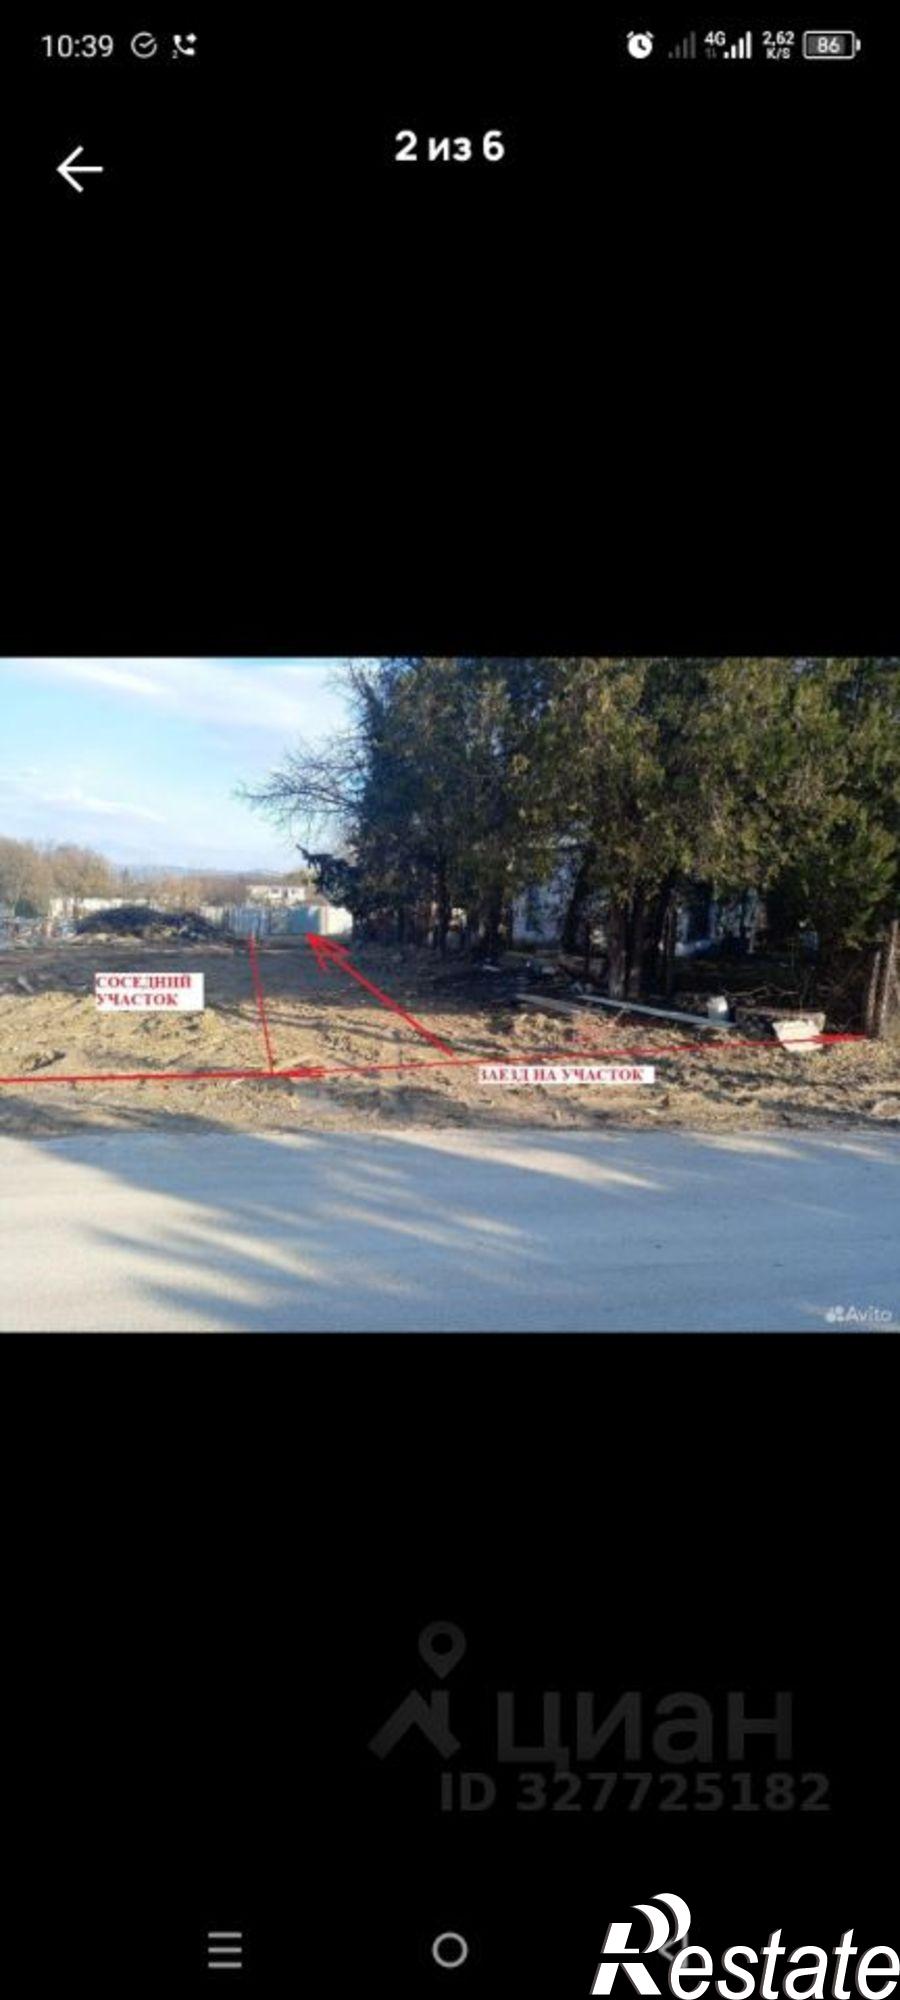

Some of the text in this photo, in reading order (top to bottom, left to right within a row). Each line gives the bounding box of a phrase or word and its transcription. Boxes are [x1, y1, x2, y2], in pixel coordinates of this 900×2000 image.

[41, 34, 114, 58] 10:39
[703, 31, 727, 47] 4G
[816, 37, 840, 54] 86
[766, 47, 791, 60] K/S
[395, 129, 505, 162] 2 из 6
